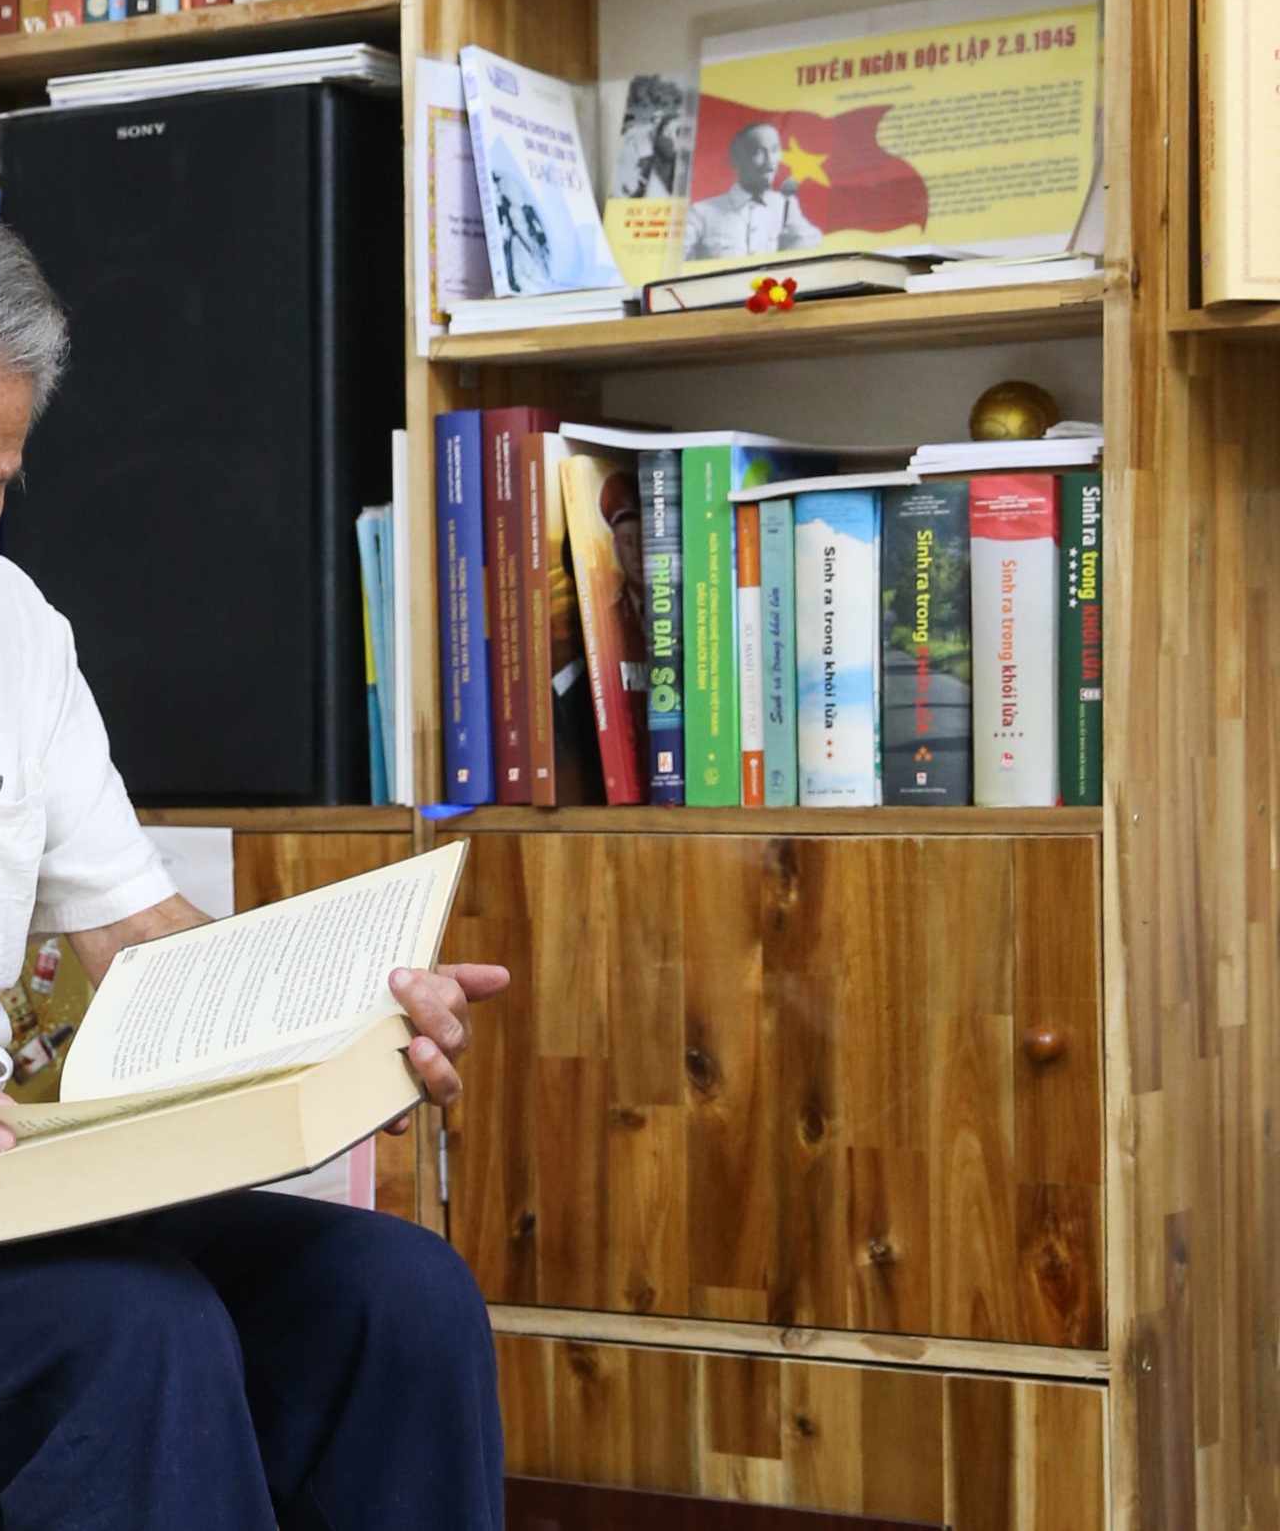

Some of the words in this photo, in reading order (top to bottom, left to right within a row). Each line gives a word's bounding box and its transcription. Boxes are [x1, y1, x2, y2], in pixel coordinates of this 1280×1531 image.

[797, 57, 853, 86] TUYÊN
[860, 50, 908, 78] NGÔN
[915, 42, 950, 73] ĐỘC
[956, 36, 991, 67] LẬP
[996, 25, 1077, 58] 2.9.1945
[116, 122, 166, 140] SONY
[653, 470, 665, 496] DAN
[654, 497, 665, 538] BROWN
[1082, 486, 1100, 525] Sinh
[916, 529, 933, 569] Sinh
[1082, 527, 1096, 547] ra
[650, 553, 672, 614] PHÁO
[824, 546, 836, 584] Sinh
[917, 573, 929, 590] ra
[1001, 559, 1016, 594] Sinh
[1077, 550, 1098, 599] trong
[825, 587, 835, 605] ra
[1002, 598, 1013, 614] ra
[822, 610, 835, 656] trong
[913, 594, 930, 642] trong
[652, 619, 677, 657] ĐÀI
[999, 617, 1014, 662] trong
[650, 666, 681, 714] SỐ
[824, 660, 837, 697] khói
[1002, 664, 1017, 699] khói
[824, 697, 838, 730] lửa
[1002, 702, 1019, 728] lửa
